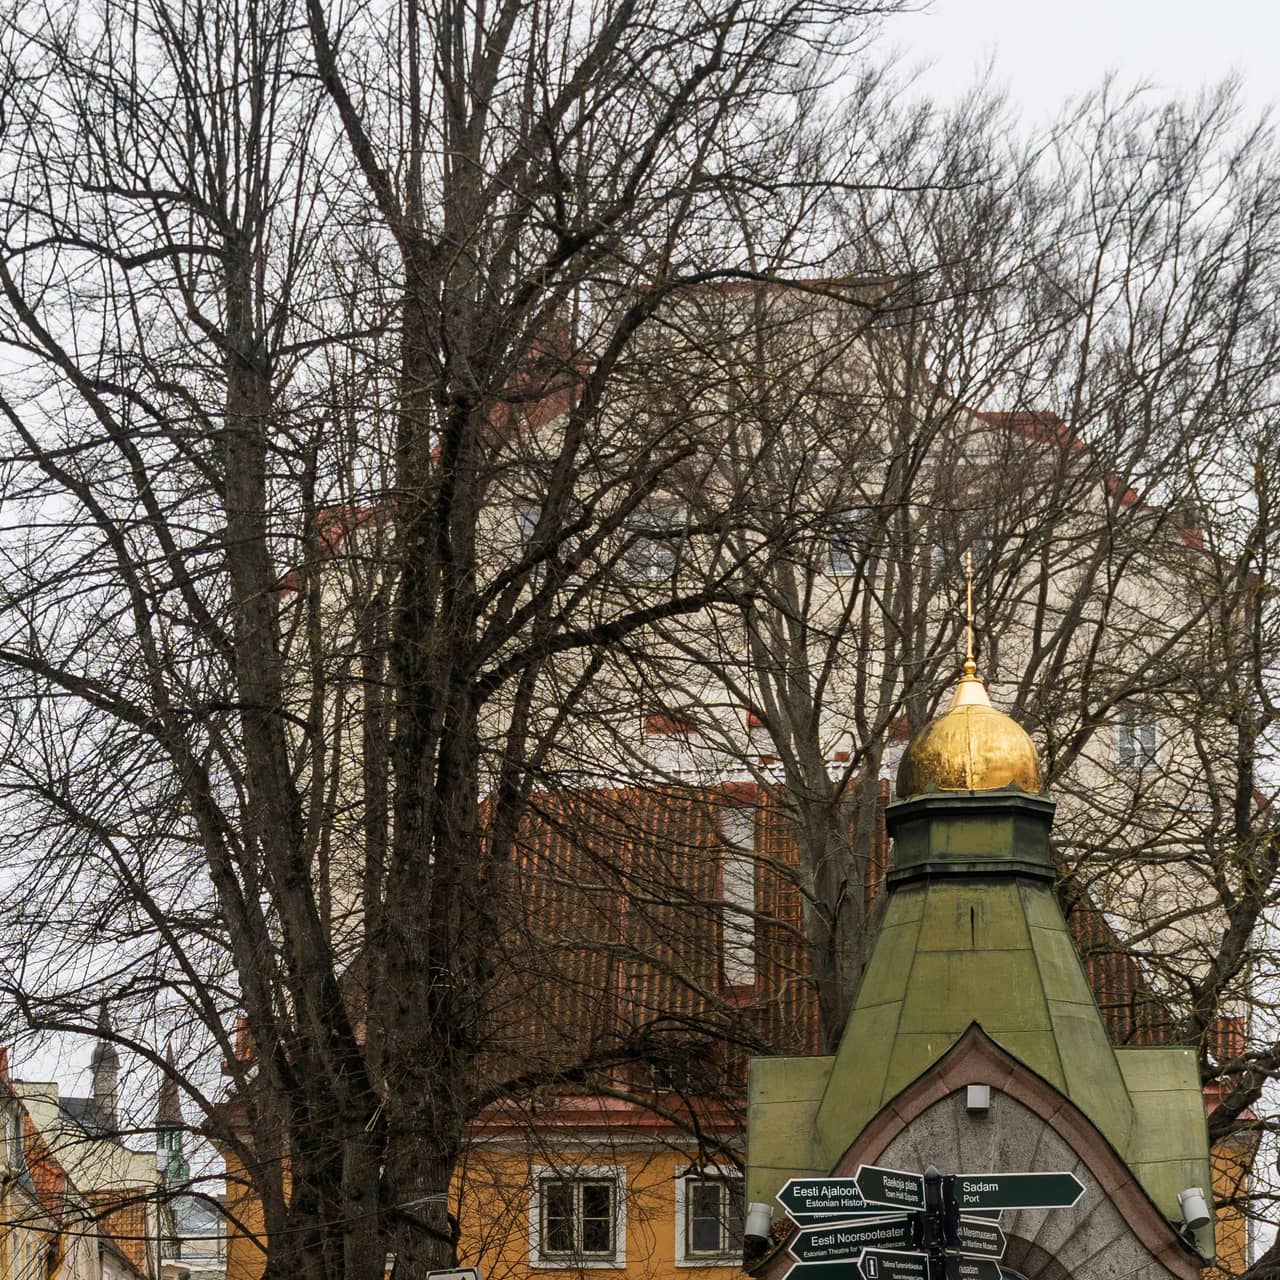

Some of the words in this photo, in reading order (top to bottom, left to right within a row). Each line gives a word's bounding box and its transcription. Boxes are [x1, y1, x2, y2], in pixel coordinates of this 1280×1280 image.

[793, 1186, 819, 1197] Eesti
[962, 1181, 999, 1192] Sadam
[806, 1200, 839, 1208] Estonian
[841, 1199, 867, 1209] History
[963, 1194, 980, 1203] Port
[811, 1235, 835, 1247] Eesti
[837, 1227, 905, 1244] Noorsooteater
